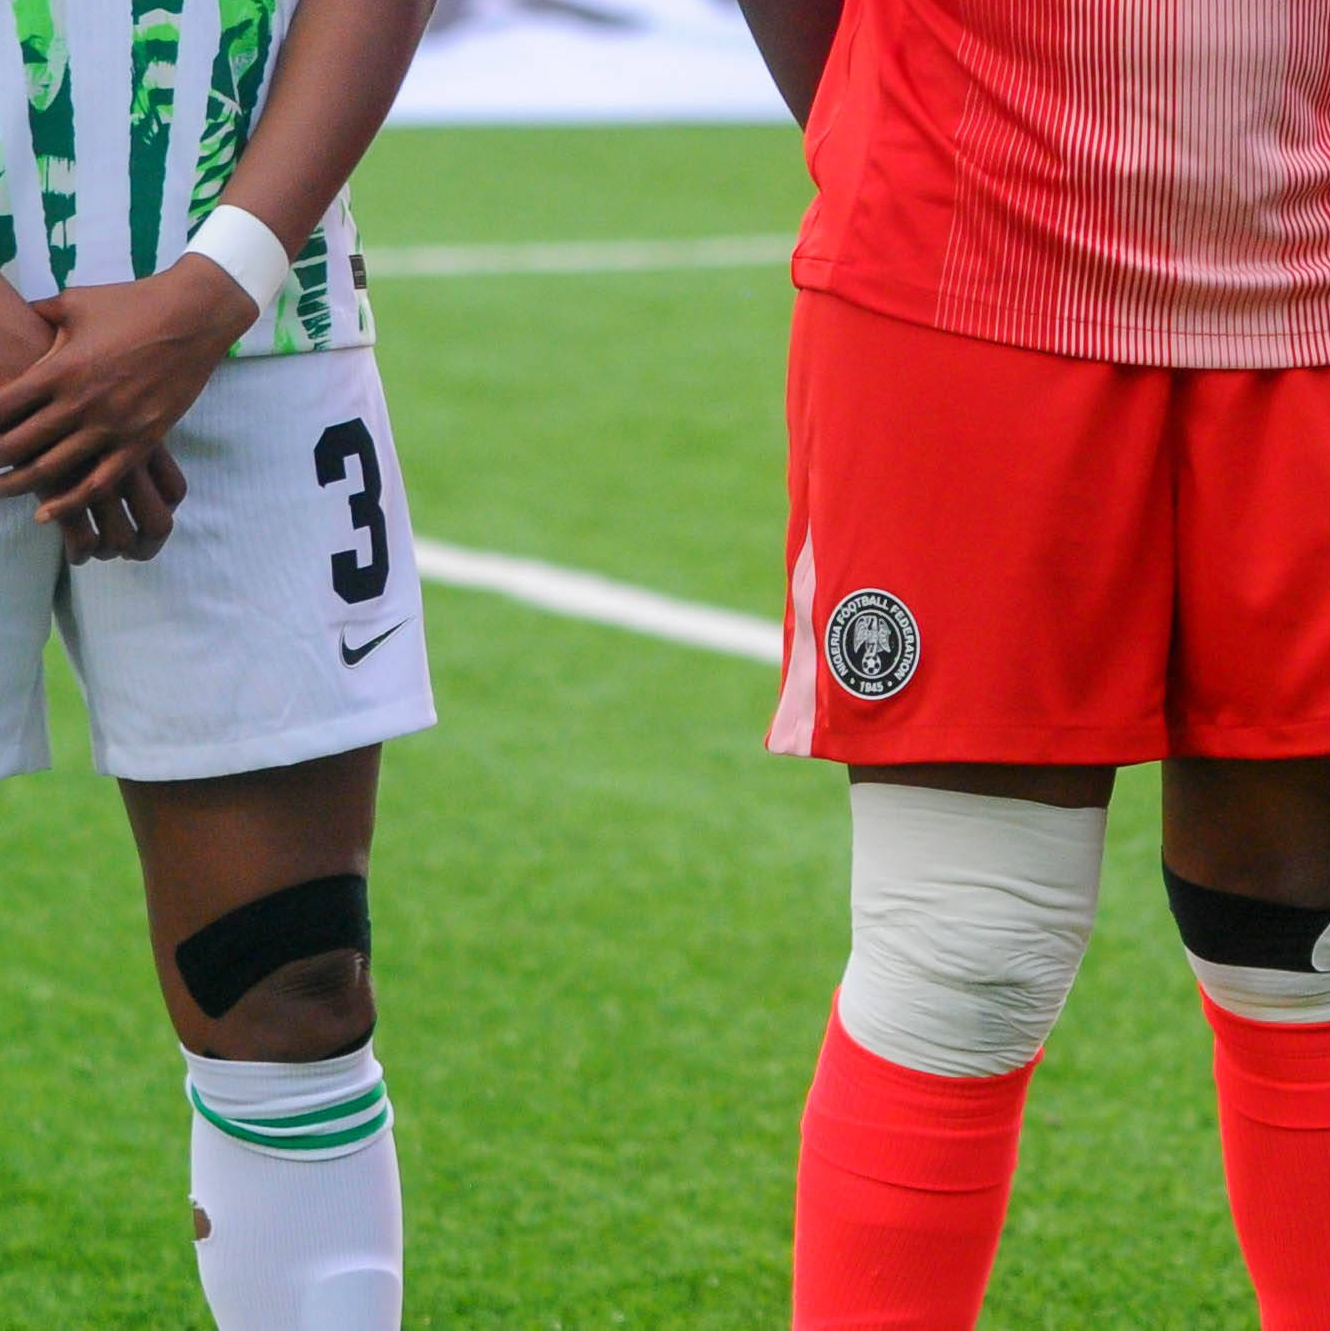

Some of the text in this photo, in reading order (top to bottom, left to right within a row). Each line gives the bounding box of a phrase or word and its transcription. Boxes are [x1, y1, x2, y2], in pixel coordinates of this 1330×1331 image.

[314, 417, 390, 604] 3
[831, 595, 915, 681] NIGERIA FOOTBALL FEDERATION
[860, 681, 883, 693] 1945
